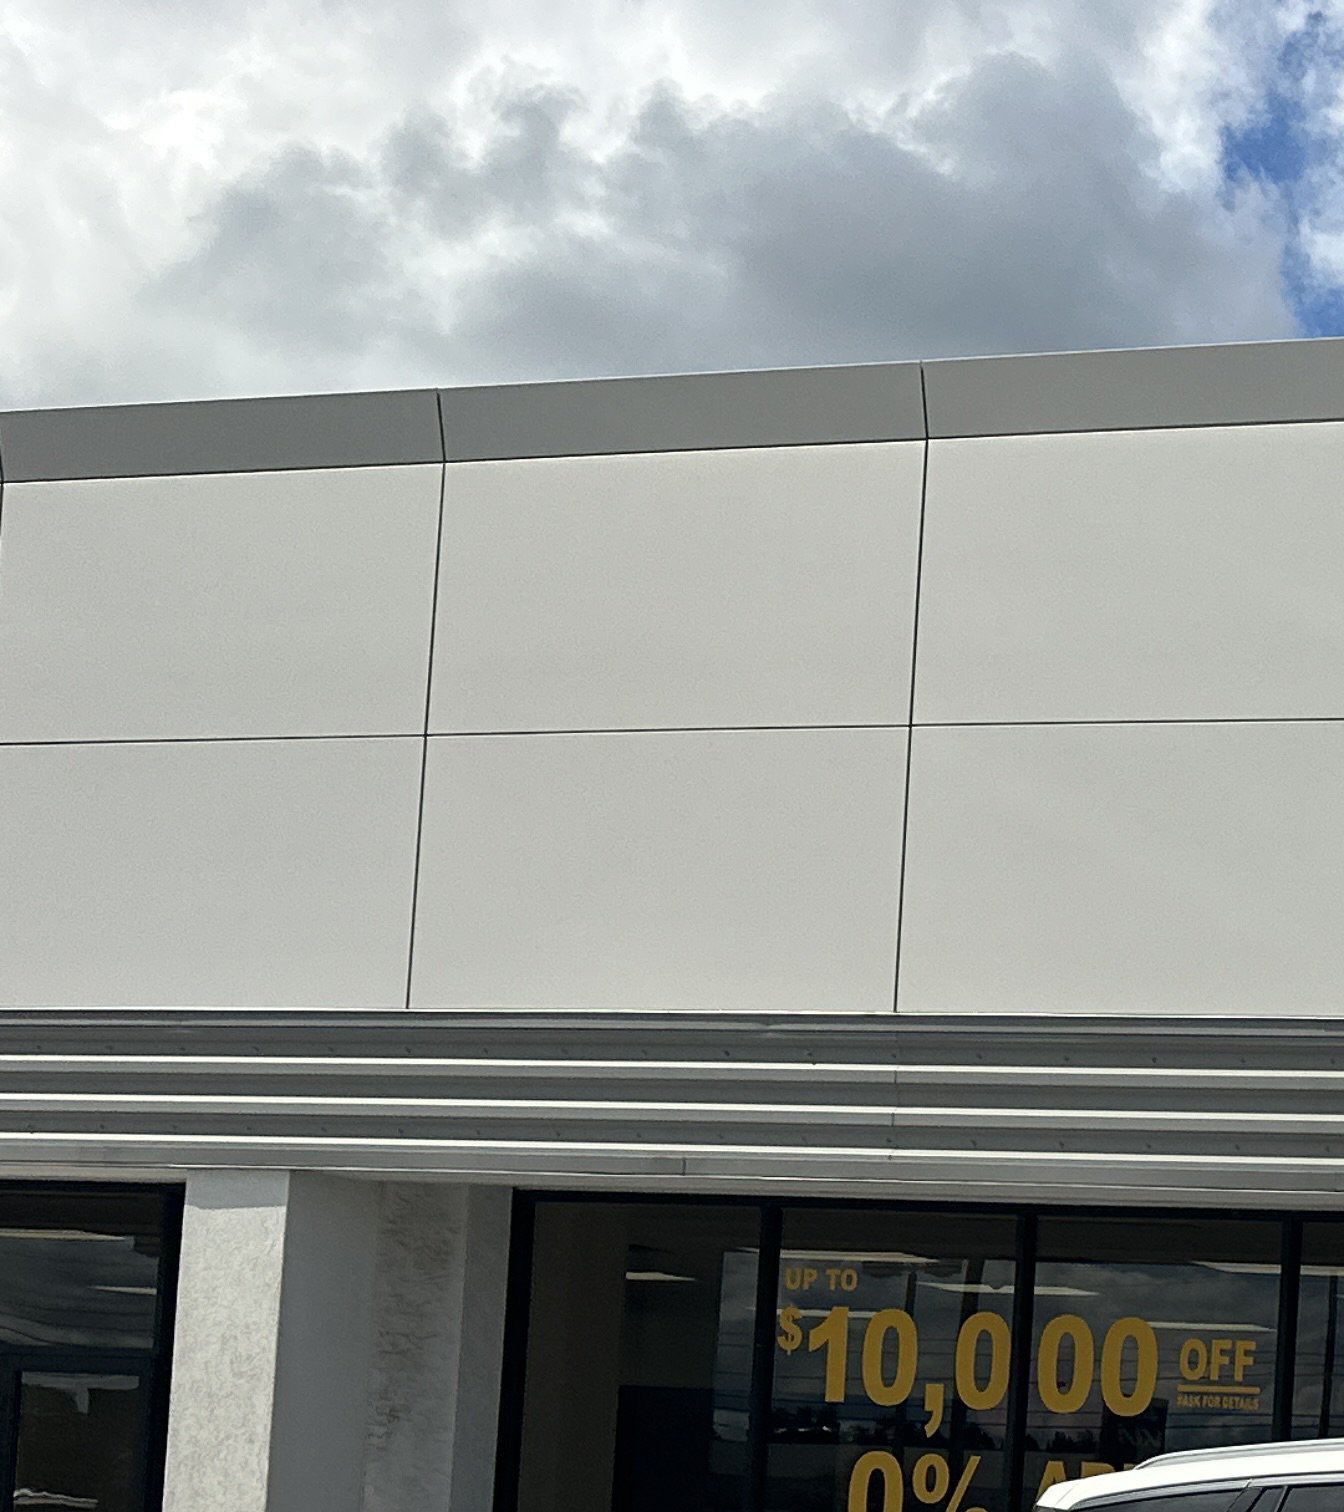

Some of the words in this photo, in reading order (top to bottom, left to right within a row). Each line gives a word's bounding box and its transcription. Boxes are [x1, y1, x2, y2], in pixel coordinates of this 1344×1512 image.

[784, 1267, 817, 1291] UP
[825, 1268, 858, 1291] TO
[777, 1305, 1158, 1438] $10,000
[1179, 1338, 1258, 1382] OFF
